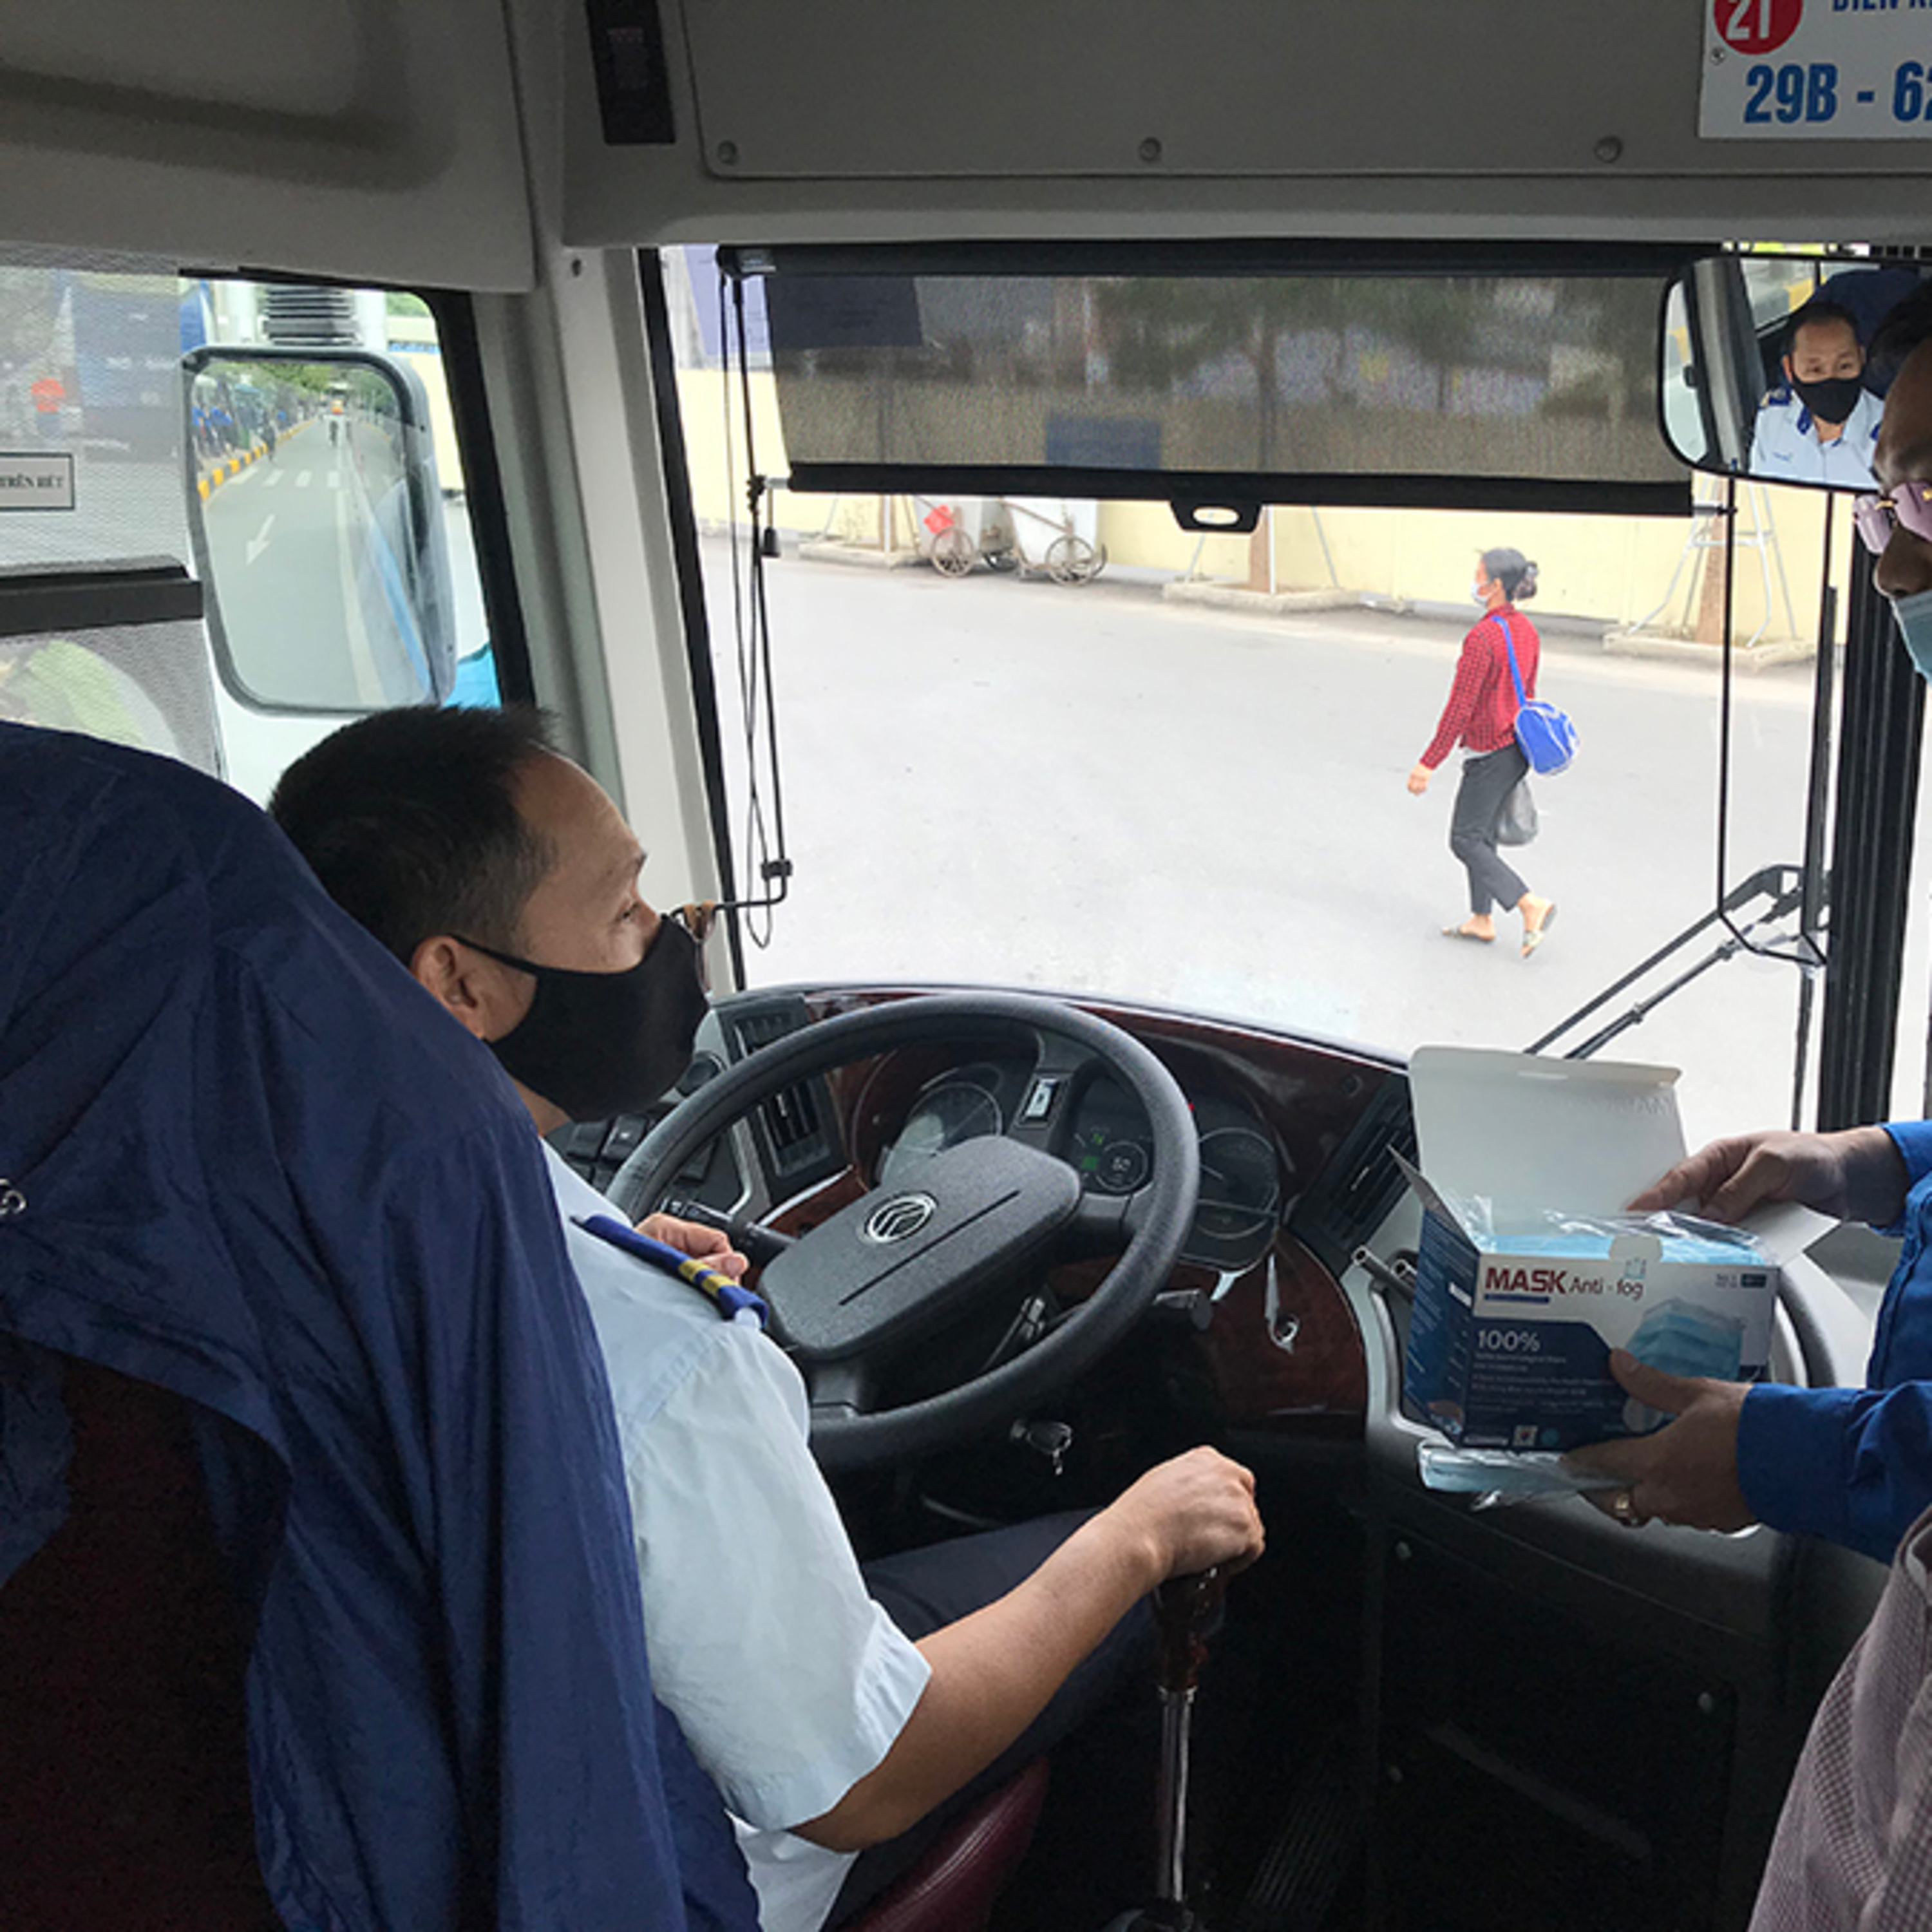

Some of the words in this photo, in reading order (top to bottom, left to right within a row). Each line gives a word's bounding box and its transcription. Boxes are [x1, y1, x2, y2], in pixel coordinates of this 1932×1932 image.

[1744, 62, 1838, 123] 29B
[1857, 91, 1875, 102] -
[1893, 61, 1932, 122] 6
[1485, 1267, 1567, 1294] MASK
[1568, 1276, 1604, 1295] Anti
[1616, 1277, 1643, 1302] fog
[1477, 1329, 1540, 1352] 100%
